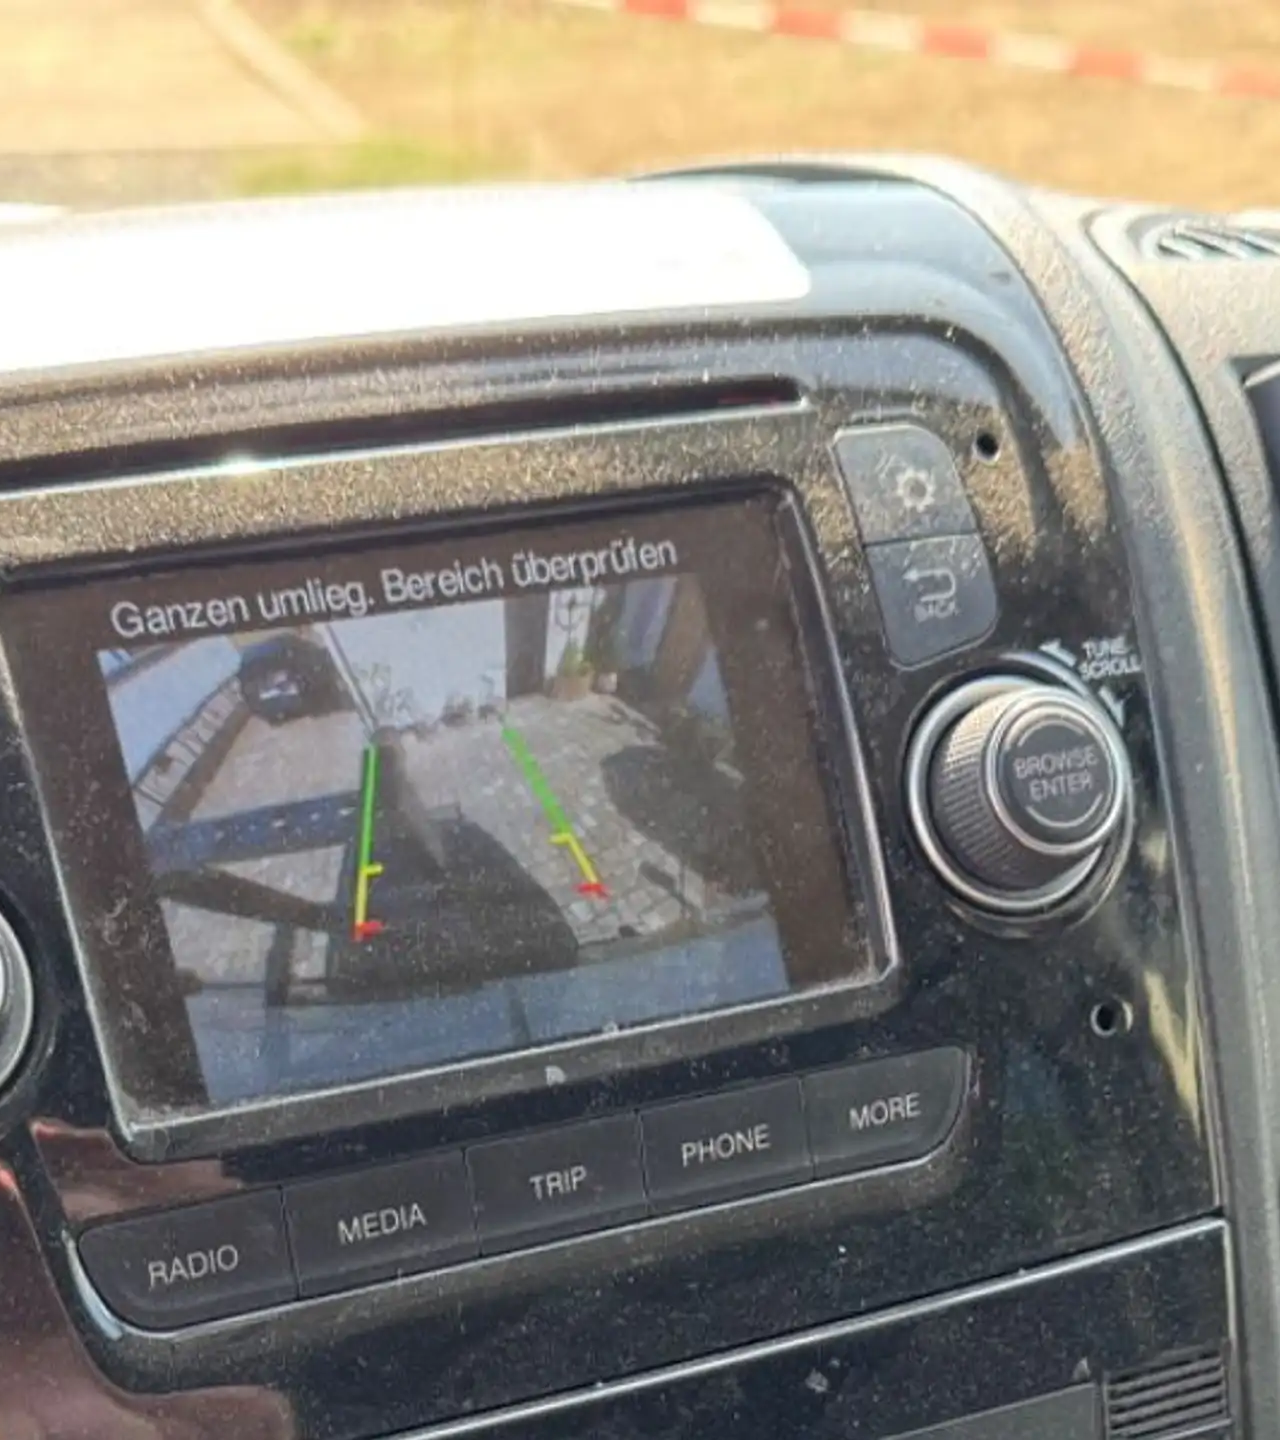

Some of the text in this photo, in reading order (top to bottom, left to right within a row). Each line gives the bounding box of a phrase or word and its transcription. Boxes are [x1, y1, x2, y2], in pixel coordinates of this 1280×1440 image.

[109, 537, 678, 638] Ganzen umlieg. Bereich überprüfen
[1078, 654, 1141, 681] SCROLL
[1013, 744, 1099, 780] BROWSE
[1029, 770, 1093, 802] ENTER
[849, 1092, 922, 1130] MORE
[680, 1123, 772, 1168] PHONE
[529, 1165, 588, 1199] TRIP
[338, 1202, 428, 1247] MEDIA
[147, 1243, 240, 1288] RADIO
